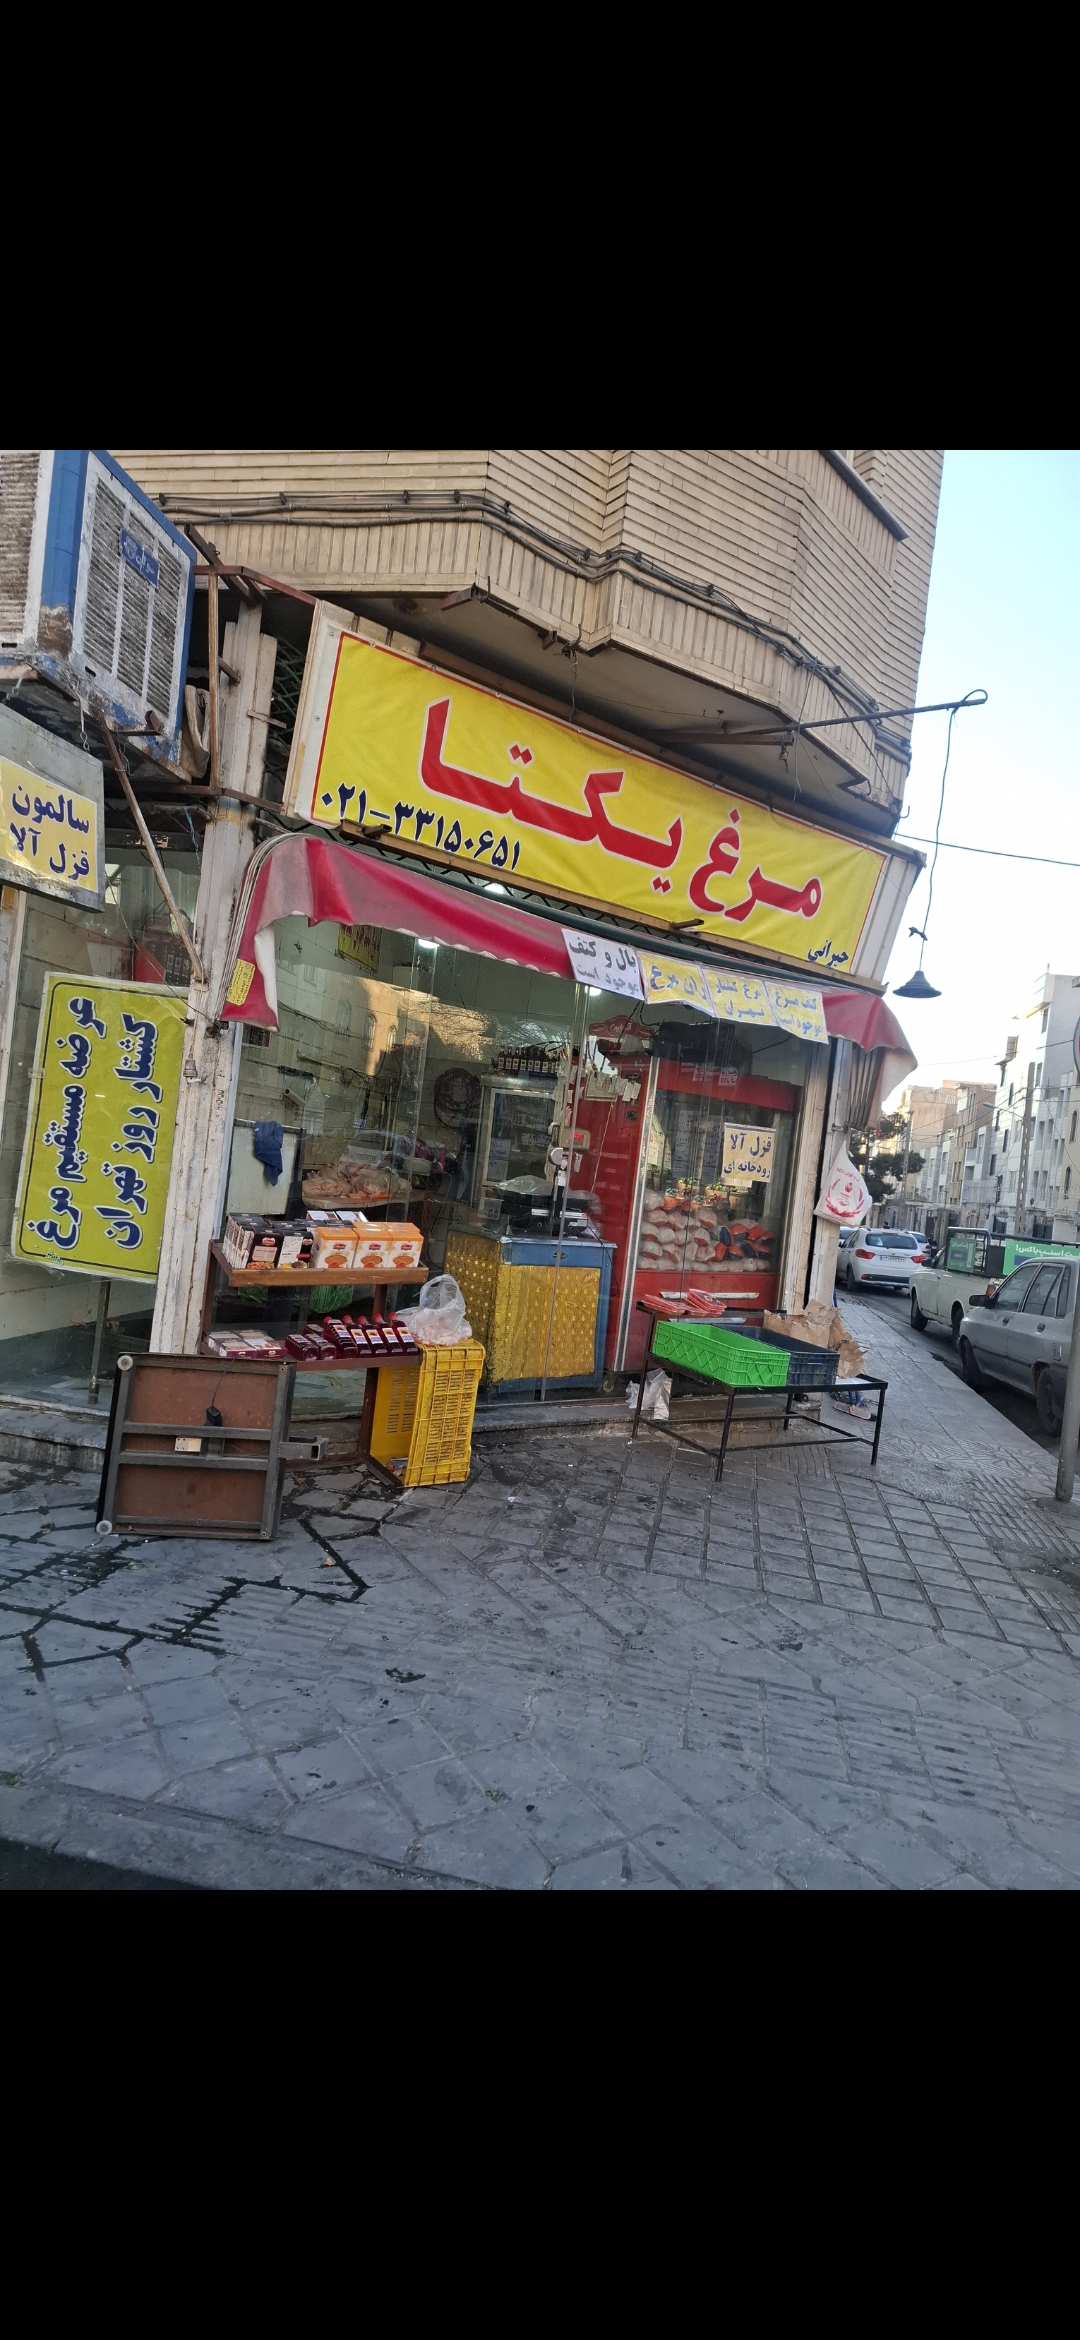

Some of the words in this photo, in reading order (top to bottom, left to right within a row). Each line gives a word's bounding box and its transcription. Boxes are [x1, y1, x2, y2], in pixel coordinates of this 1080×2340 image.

[420, 698, 682, 893] یکتا
[12, 785, 89, 834] سالمون
[10, 822, 41, 856] آلا
[50, 843, 89, 880] قزل
[689, 808, 822, 922] مرغ
[569, 937, 597, 957] کتف
[604, 951, 612, 968] و
[616, 947, 637, 973] بال
[576, 964, 599, 980] است
[605, 973, 639, 995] موجود
[717, 978, 738, 993] کشتار
[724, 999, 765, 1018] تهران
[775, 988, 799, 1009] مرغ
[780, 1012, 794, 1026] است
[796, 1018, 823, 1037] موجود
[55, 997, 106, 1078] عرضه
[114, 1013, 163, 1103] کشتار
[42, 1084, 88, 1182] مستقیم
[111, 1106, 159, 1163] روز
[731, 1133, 747, 1149] آلا
[750, 1136, 771, 1157] قزل
[723, 1161, 735, 1174] ای
[738, 1160, 771, 1178] رودخانه
[95, 1161, 147, 1249] تهران
[27, 1186, 81, 1249] مرغ
